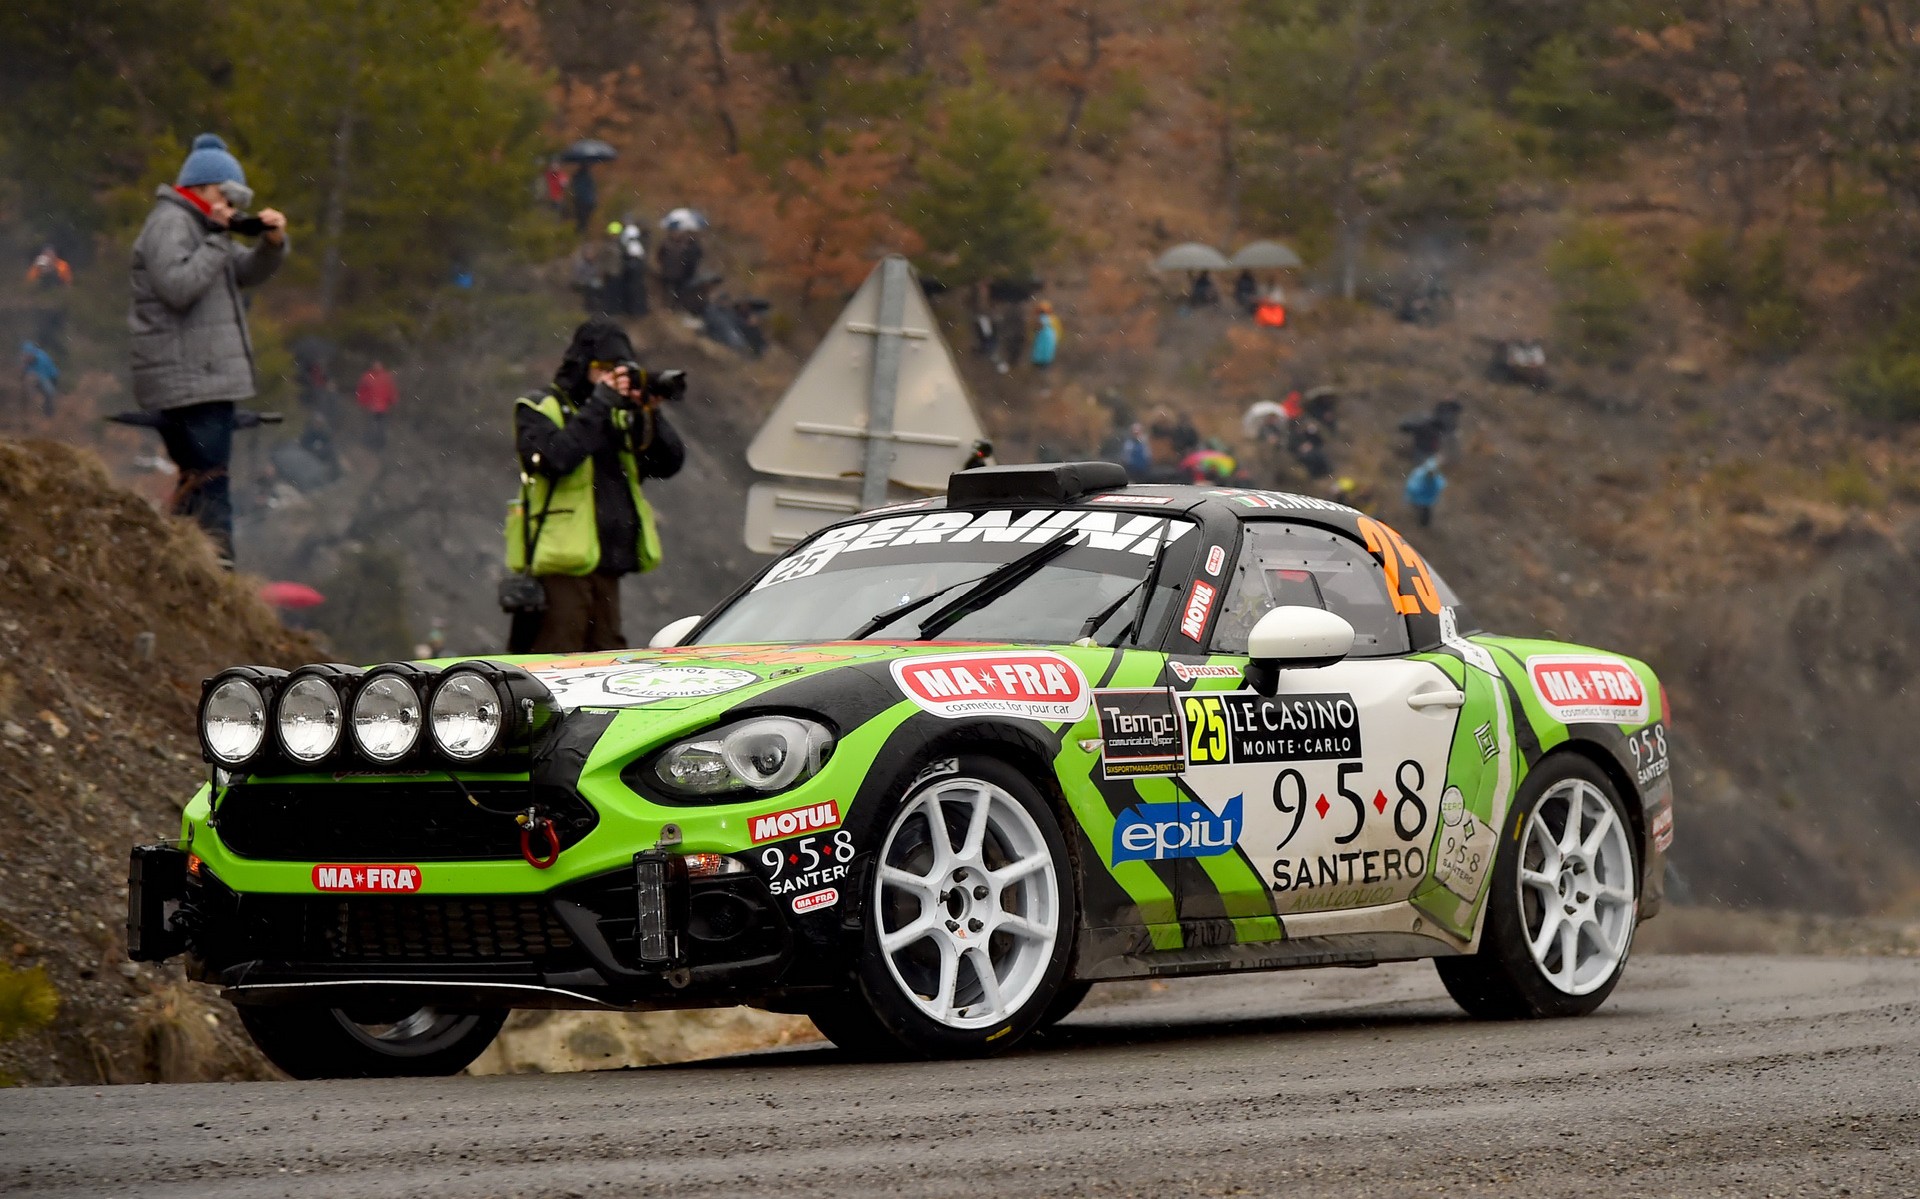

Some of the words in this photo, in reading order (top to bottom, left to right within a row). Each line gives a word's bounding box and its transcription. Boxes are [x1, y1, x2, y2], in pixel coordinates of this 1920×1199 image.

[770, 552, 825, 583] 25
[1357, 516, 1442, 615] 25
[1182, 583, 1214, 640] MOTUL
[1186, 666, 1240, 676] PHOENIX
[946, 701, 1005, 713] cosmetics
[1006, 701, 1023, 711] for
[1027, 704, 1050, 715] your
[1053, 705, 1070, 714] car
[1230, 702, 1258, 732] LE
[1261, 700, 1355, 732] CASINO
[1185, 698, 1227, 761] 25
[1638, 756, 1670, 785] SANTERO
[755, 803, 836, 840] MOTUL
[1121, 811, 1234, 860] epiu
[1272, 847, 1425, 892] SANTERO
[1442, 858, 1474, 885] SANTERO
